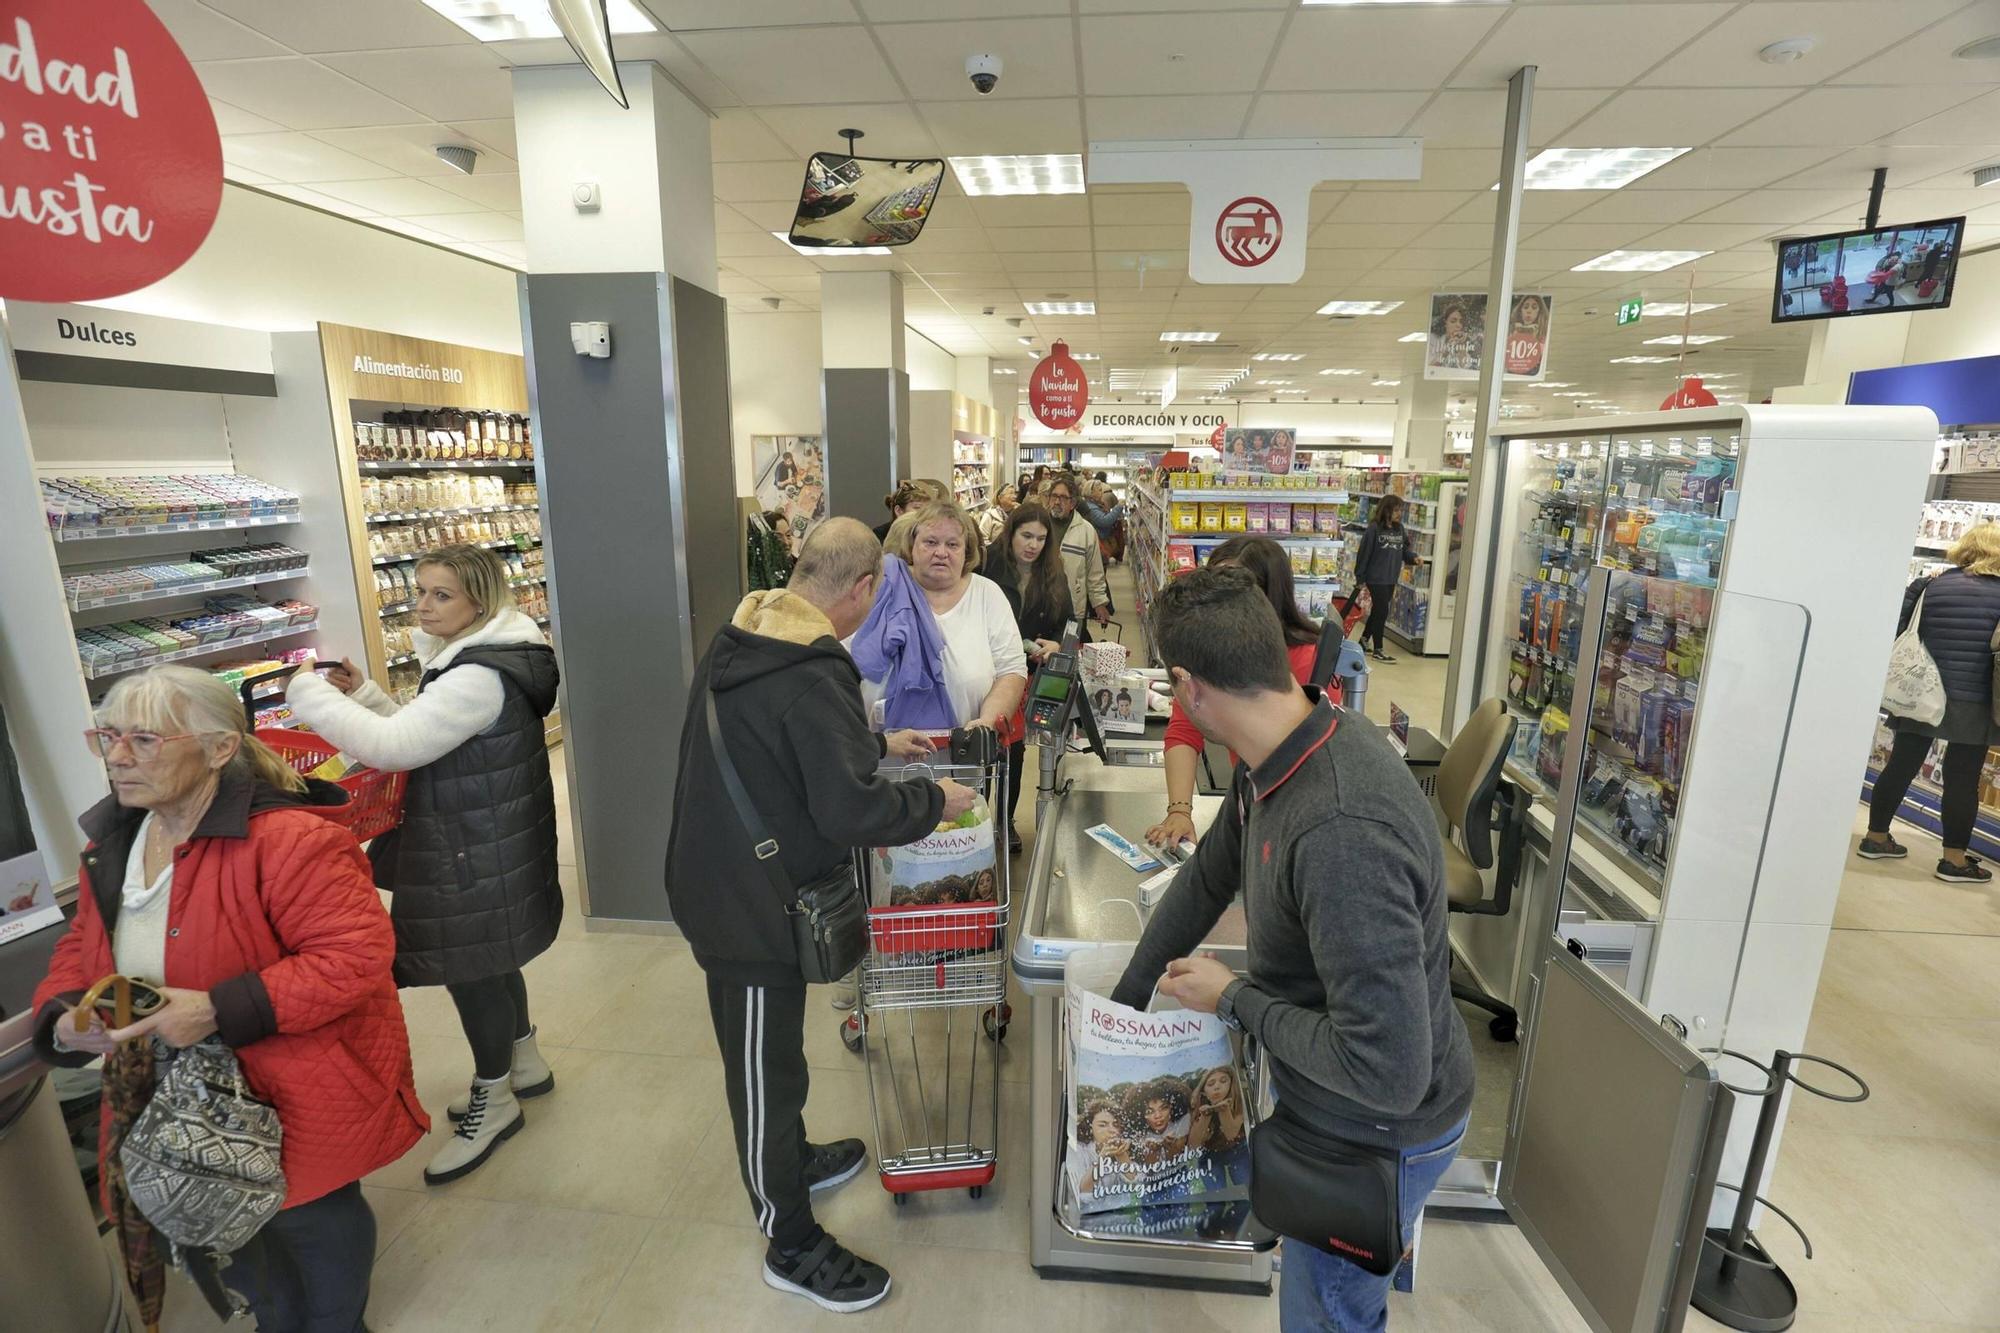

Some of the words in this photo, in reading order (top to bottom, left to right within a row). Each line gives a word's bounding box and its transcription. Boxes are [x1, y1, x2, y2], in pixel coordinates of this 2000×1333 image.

[21, 121, 51, 152] a
[62, 125, 97, 161] ti
[57, 318, 137, 347] Dulces
[1506, 340, 1538, 359] -10%
[353, 355, 440, 381] Alimentación
[441, 367, 463, 384] BIO
[1053, 362, 1064, 377] La
[1041, 376, 1079, 392] Navidad
[1683, 393, 1696, 406] La
[1040, 403, 1050, 417] te
[1051, 404, 1077, 420] gusta
[1093, 412, 1176, 427] DECORACIÓN
[1180, 415, 1188, 426] Y
[1192, 415, 1225, 427] OCIO
[1457, 431, 1462, 440] Y
[1268, 454, 1288, 466] -10%
[1091, 1008, 1202, 1038] ROSSMANN
[1125, 1037, 1134, 1045] tu
[1093, 1145, 1203, 1181] ¡Bienvenidos
[1093, 1158, 1214, 1199] inauguración!
